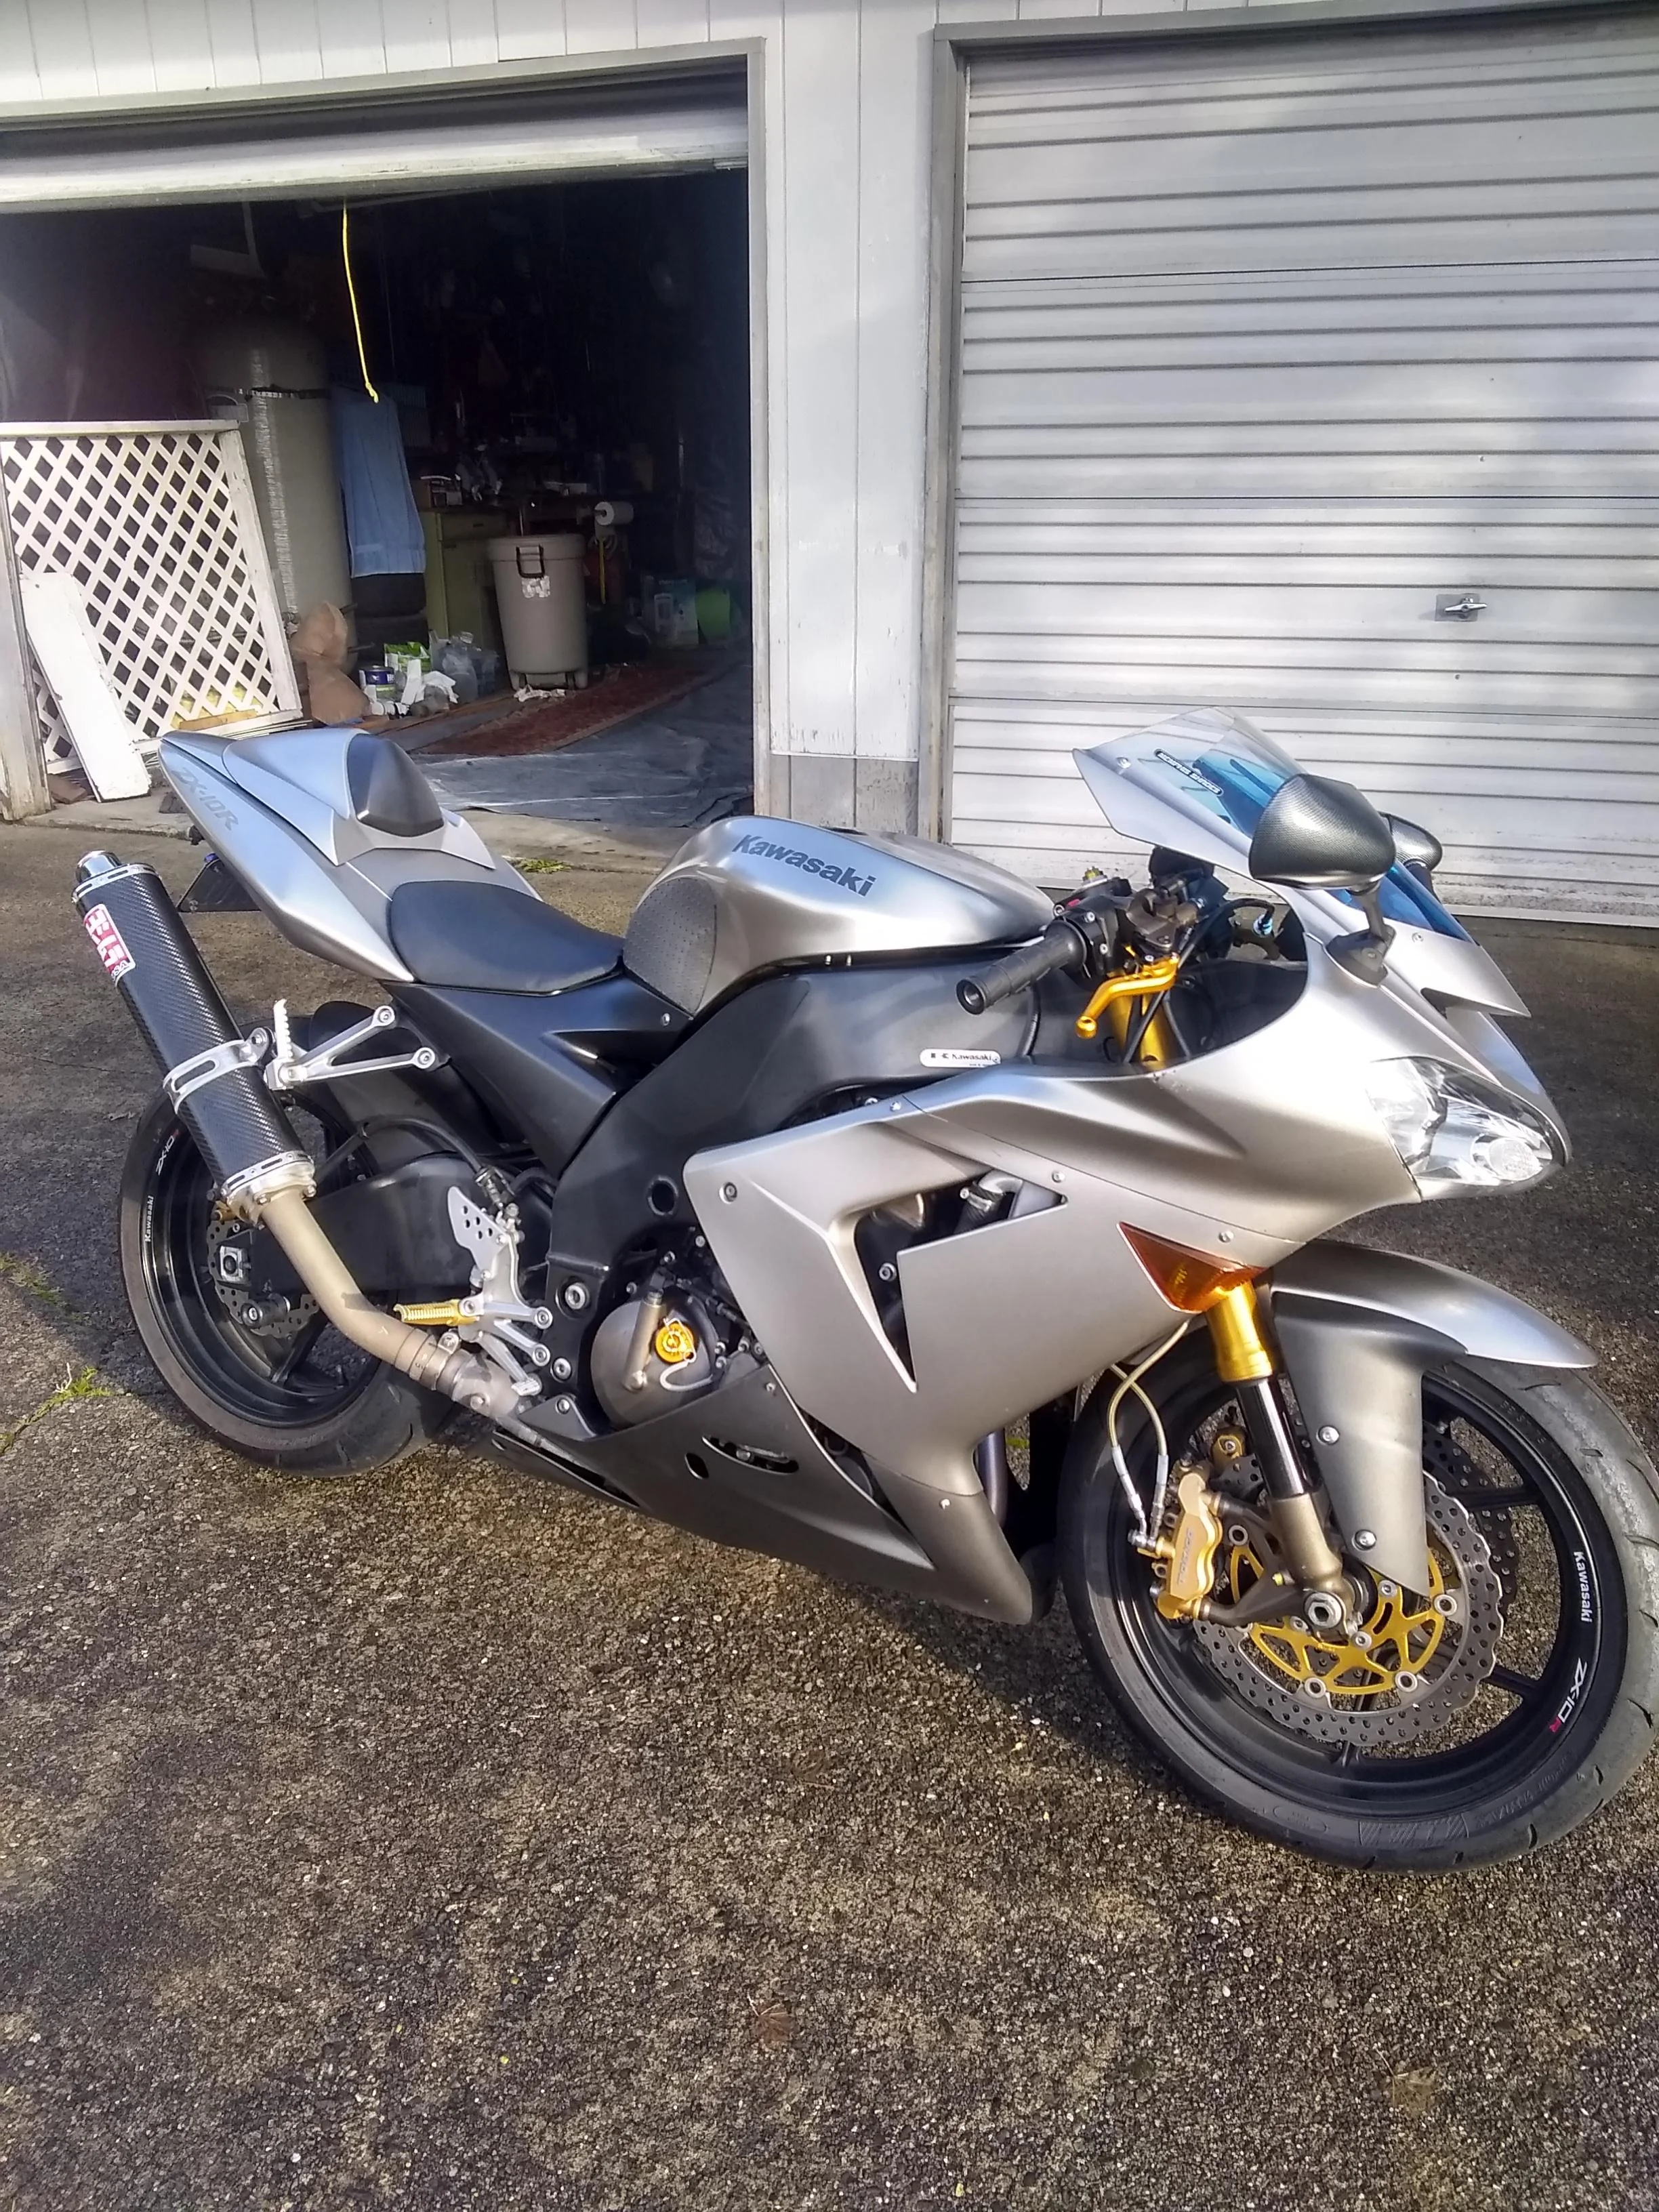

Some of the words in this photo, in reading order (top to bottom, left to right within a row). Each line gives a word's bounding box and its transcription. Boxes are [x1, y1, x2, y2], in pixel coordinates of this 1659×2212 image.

[732, 834, 876, 897] Kawasaki
[951, 1053, 991, 1061] Kawasaki
[144, 1195, 154, 1242] Kawasaki
[1573, 1551, 1593, 1622] Kawasaki
[1549, 1657, 1588, 1732] ZX-10R
